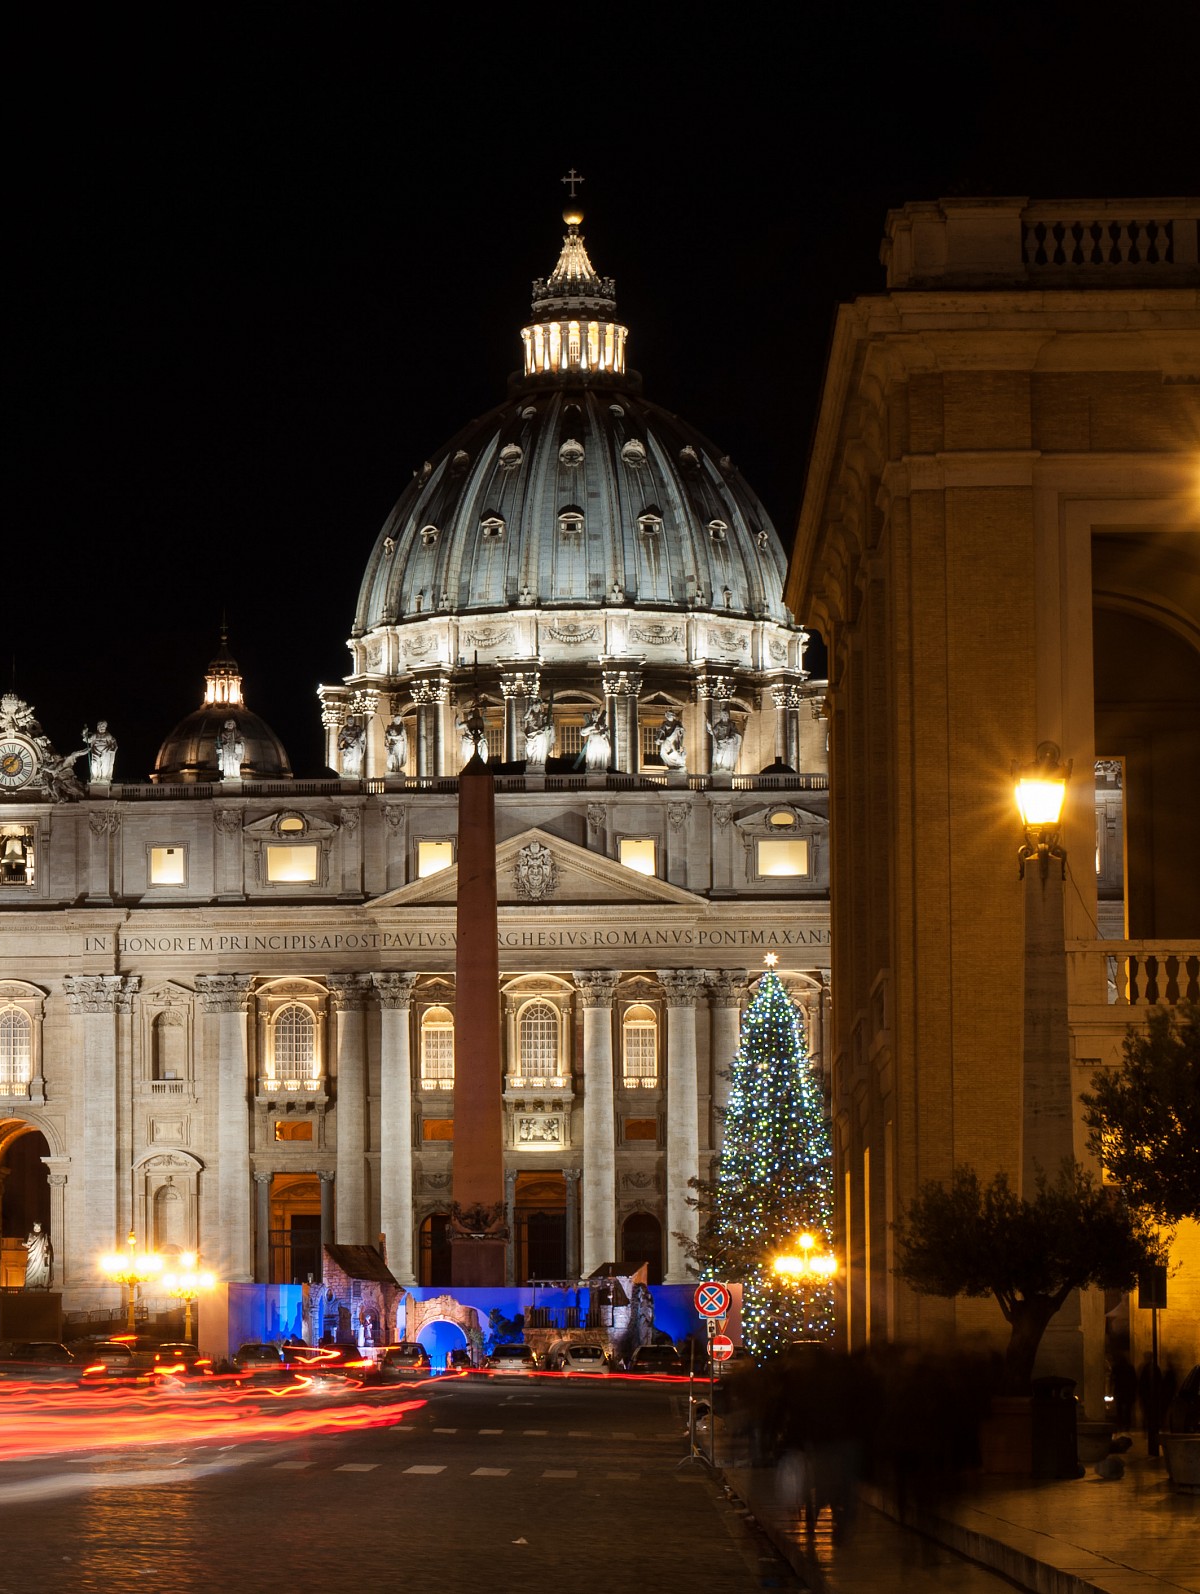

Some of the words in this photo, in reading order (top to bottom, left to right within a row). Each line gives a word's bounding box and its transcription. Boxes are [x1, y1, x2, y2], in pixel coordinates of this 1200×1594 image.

[85, 937, 106, 950] IN
[117, 937, 213, 951] HONOREM
[220, 935, 316, 950] PRINCIPIS
[320, 933, 380, 948] APOST
[383, 932, 446, 947] PAVLVS
[497, 931, 587, 946] RGHESIVS
[593, 930, 692, 945] ROMANVS
[699, 930, 748, 944] PONT
[750, 930, 793, 944] MAX
[796, 929, 822, 944] AN
